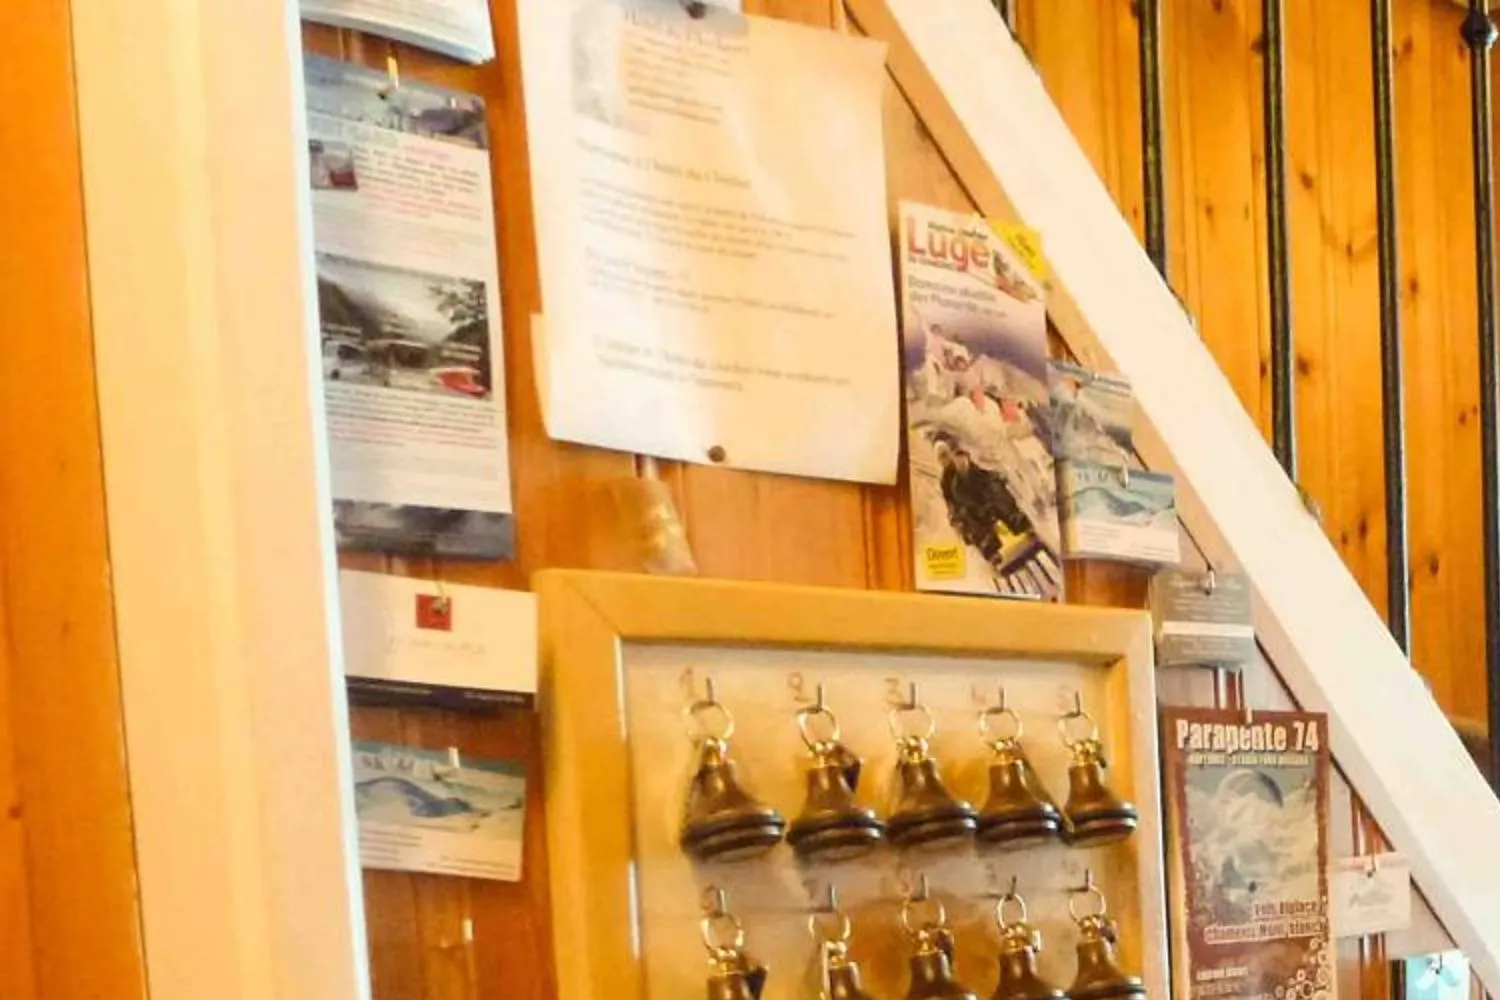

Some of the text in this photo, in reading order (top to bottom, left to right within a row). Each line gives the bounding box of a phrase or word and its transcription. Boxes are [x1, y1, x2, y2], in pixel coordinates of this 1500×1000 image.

[907, 215, 990, 272] Luge
[1175, 718, 1319, 754] Parapente 74
